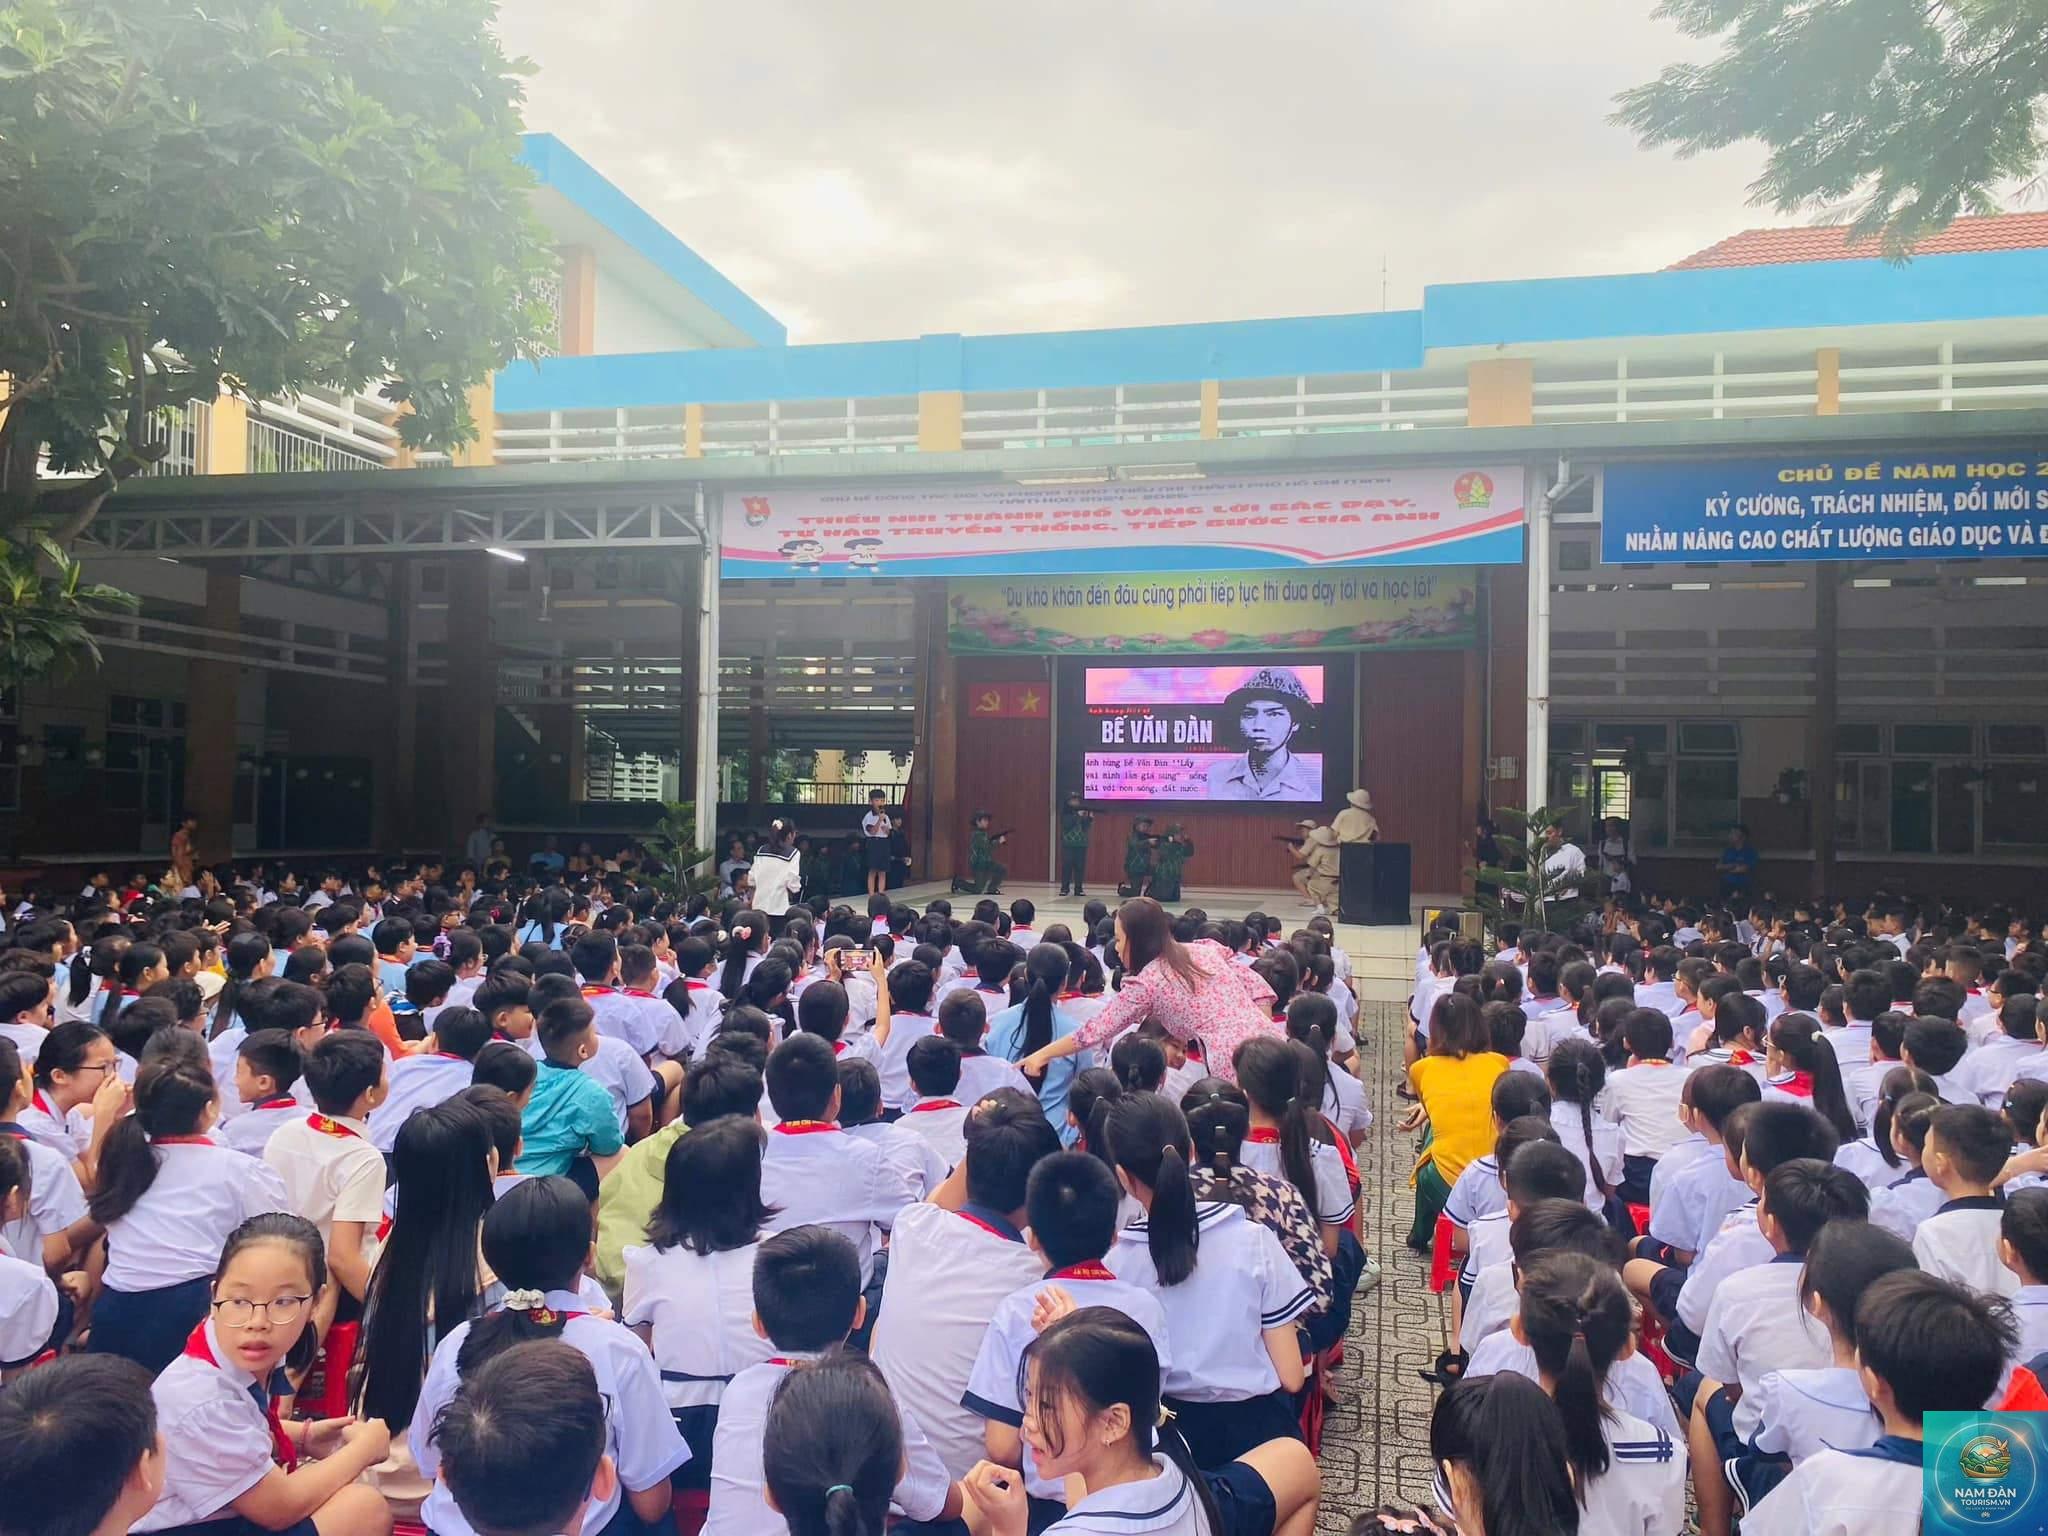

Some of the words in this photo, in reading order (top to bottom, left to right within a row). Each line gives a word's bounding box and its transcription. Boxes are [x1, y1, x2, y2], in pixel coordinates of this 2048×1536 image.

[1777, 462, 1834, 483] CHỦ
[1844, 461, 1881, 481] ĐỀ
[1893, 462, 1956, 480] NĂM
[1966, 462, 2027, 479] HỌC
[1705, 491, 1730, 517] KỶ
[1735, 494, 1806, 519] CƯƠNG,
[1811, 489, 1873, 514] TRÁCH
[1881, 488, 1949, 517] NHIỆM,
[1954, 481, 1988, 511] ĐỔI
[1993, 485, 2031, 510] MỚI
[888, 513, 937, 523] NHI
[1372, 511, 1441, 522] ANH
[1626, 523, 1677, 551] NHẰM
[1683, 526, 1733, 550] NÂNG
[1739, 529, 1777, 550] CAO
[1781, 520, 1834, 549] CHẤT
[1838, 525, 1902, 553] LƯỢNG
[1908, 523, 1955, 548] GIÁO
[1961, 526, 2002, 552] DỤC
[2007, 519, 2035, 545] VÀ
[1263, 579, 1279, 601] thi
[1101, 715, 1129, 744] BẾ
[1130, 714, 1168, 744] VĂN
[1173, 714, 1213, 744] ĐÀN
